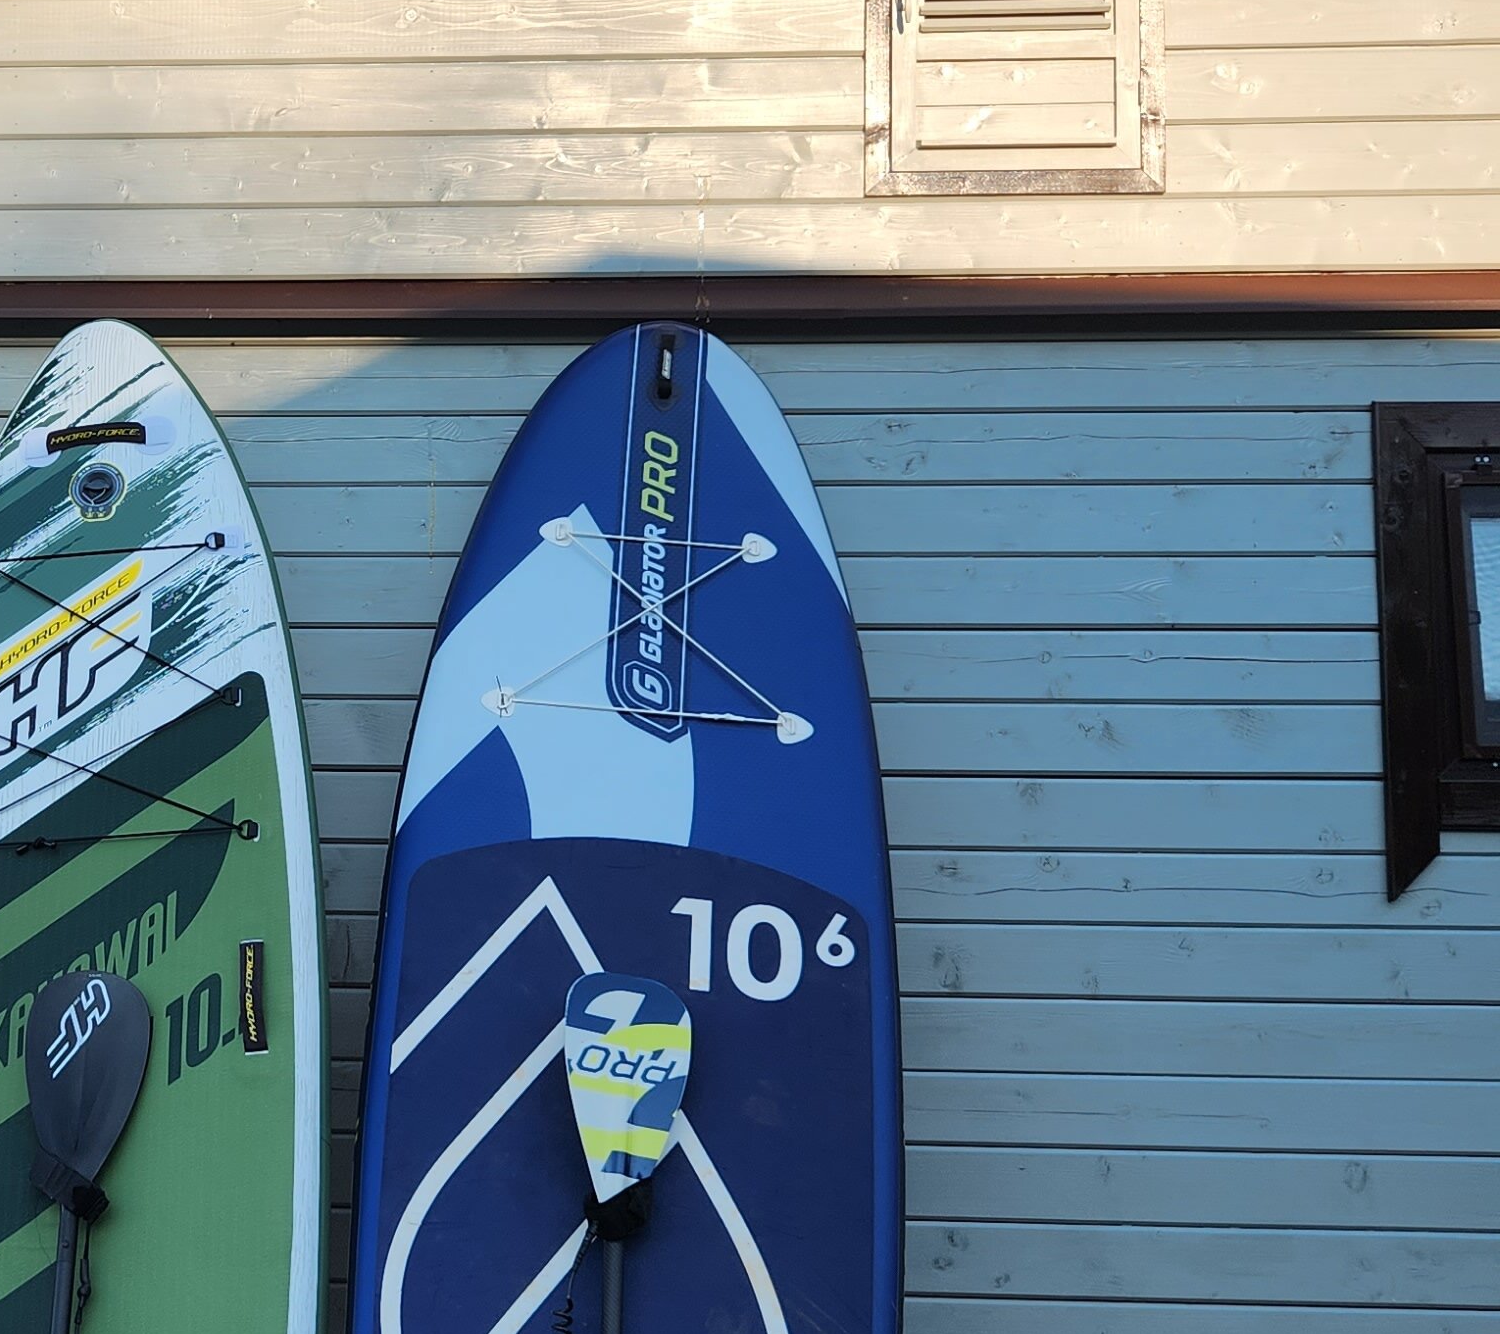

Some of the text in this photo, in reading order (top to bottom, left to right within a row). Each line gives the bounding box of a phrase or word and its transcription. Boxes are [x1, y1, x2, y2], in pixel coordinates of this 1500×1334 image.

[641, 431, 678, 522] PRO
[0, 573, 131, 670] HYDRO-FORCE
[246, 944, 258, 1042] HYDRO-FORCE
[577, 1045, 676, 1084] PRO
